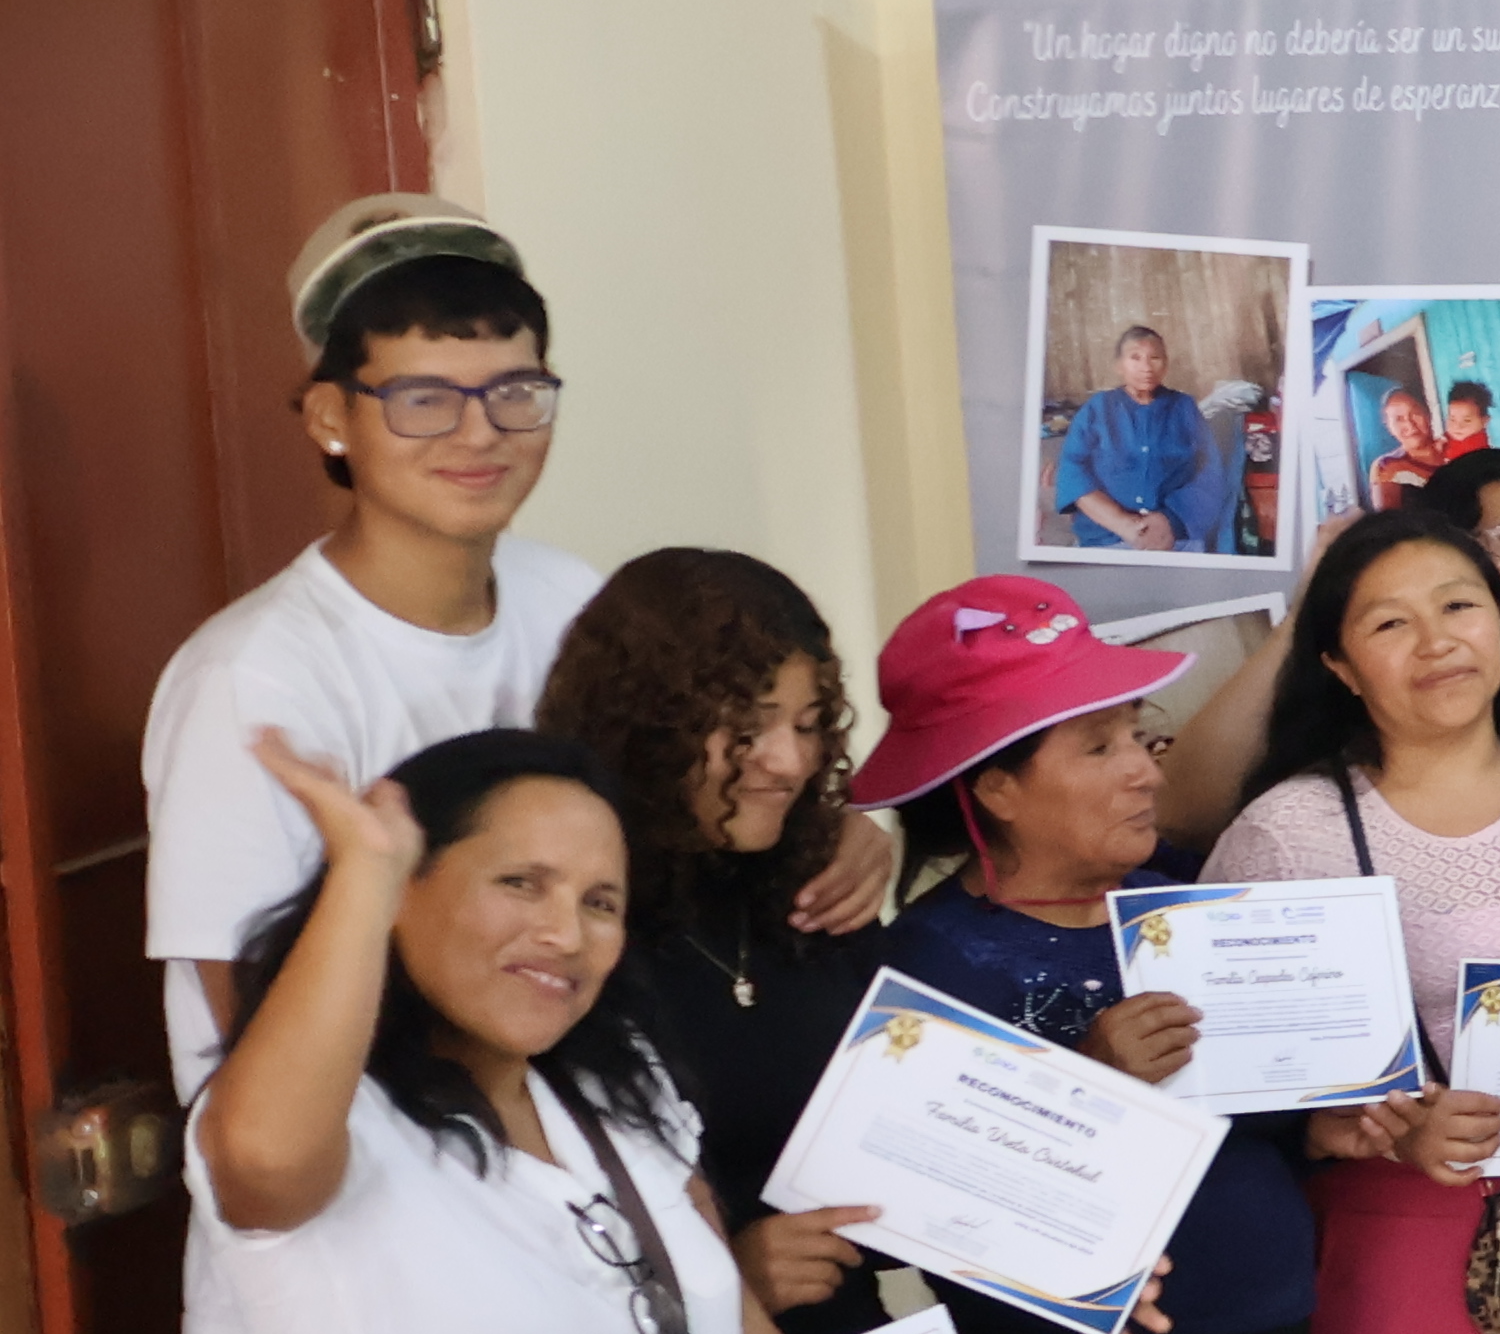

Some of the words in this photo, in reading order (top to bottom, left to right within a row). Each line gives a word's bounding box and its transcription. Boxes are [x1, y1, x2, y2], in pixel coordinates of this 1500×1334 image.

[1082, 21, 1155, 74] hogar
[1165, 20, 1235, 72] digno
[1246, 28, 1277, 56] no
[1286, 20, 1381, 55] debería
[1386, 26, 1424, 55] ser
[1432, 27, 1466, 53] un
[967, 80, 1157, 133] Construyamos
[1157, 82, 1243, 137] juntos
[1252, 74, 1343, 128] lugares
[1354, 75, 1385, 112] de
[957, 1072, 1097, 1139] RECONOCIMIENTO
